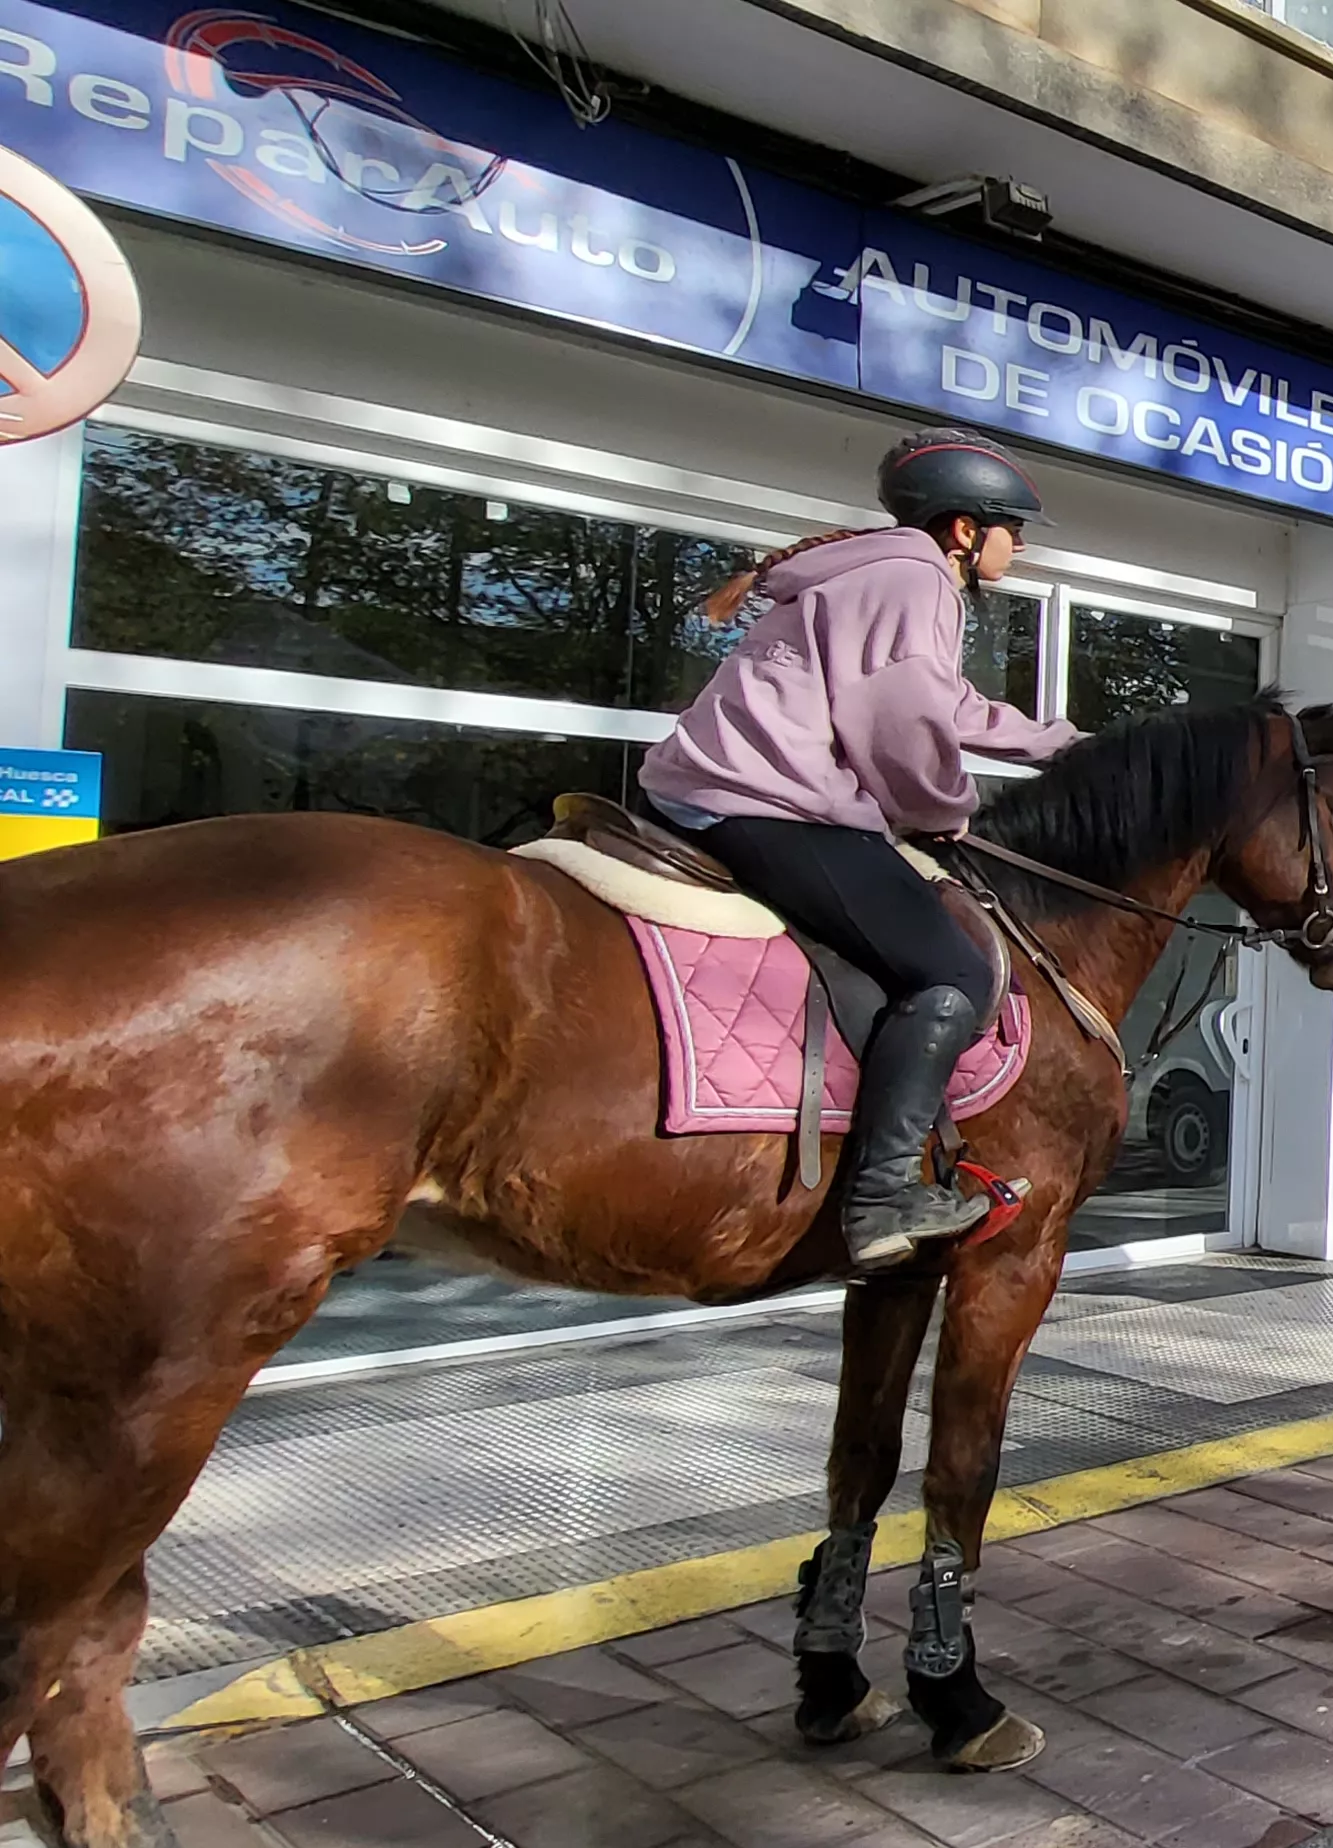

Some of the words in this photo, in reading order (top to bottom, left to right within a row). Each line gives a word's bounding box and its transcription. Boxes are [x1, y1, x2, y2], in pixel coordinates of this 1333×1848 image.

[0, 27, 678, 284] ReparAuto
[941, 344, 1051, 418] DE
[0, 767, 78, 783] Huesca
